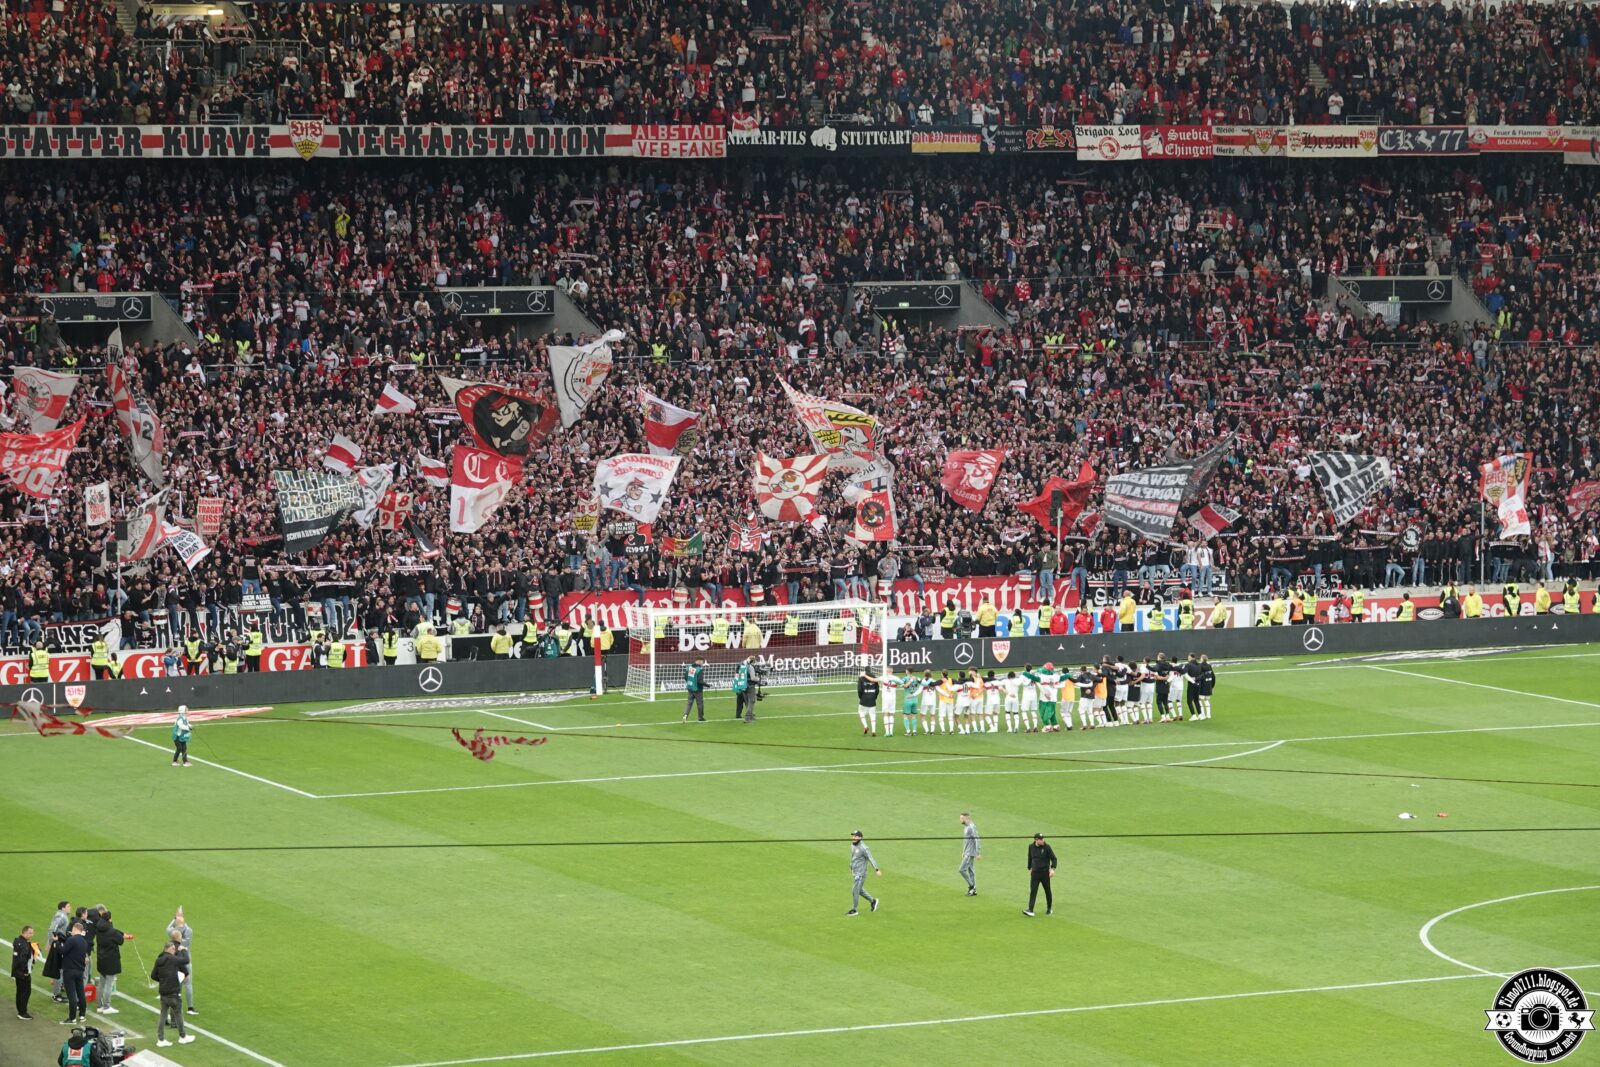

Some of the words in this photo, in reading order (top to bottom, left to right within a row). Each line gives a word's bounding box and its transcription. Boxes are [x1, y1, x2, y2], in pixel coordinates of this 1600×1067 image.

[635, 124, 725, 140] ALBSTADT
[841, 129, 912, 146] STUTTGART
[911, 131, 932, 144] Old
[933, 130, 977, 144] Warriors
[1075, 126, 1114, 138] Brigada
[1118, 126, 1139, 137] Loca
[1167, 128, 1209, 141] Suebia
[1438, 129, 1464, 151] 77
[162, 126, 270, 156] KURVE
[338, 126, 607, 157] NECKARSTADION
[637, 141, 725, 157] VFB-FANS
[757, 651, 885, 672] Mercedes-Benz
[889, 647, 933, 666] Bank
